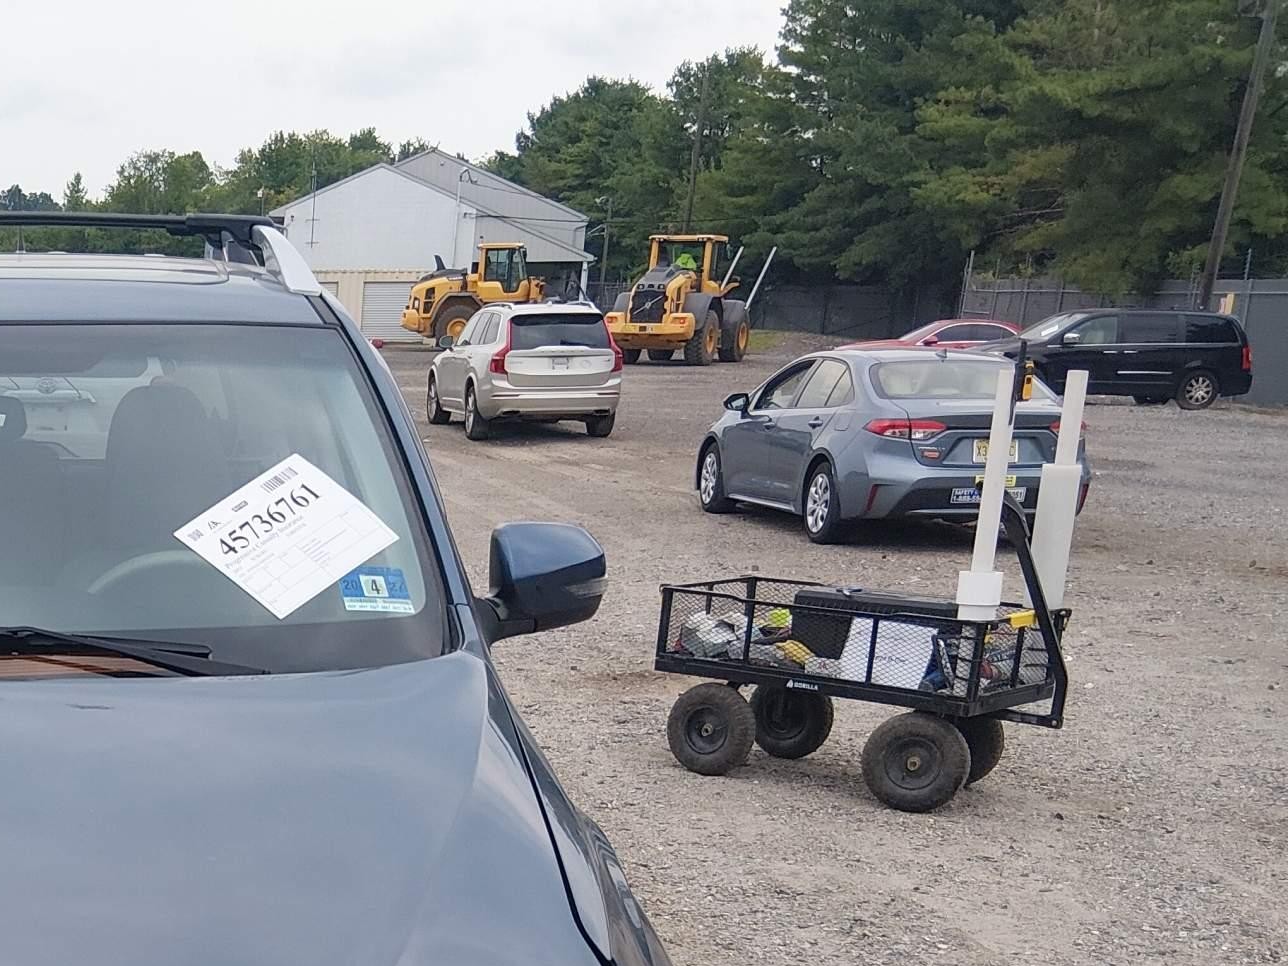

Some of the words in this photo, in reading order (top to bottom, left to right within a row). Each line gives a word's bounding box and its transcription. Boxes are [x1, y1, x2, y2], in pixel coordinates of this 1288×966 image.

[218, 483, 321, 557] 45736761
[371, 579, 380, 595] 4
[794, 682, 818, 691] GORILLA
